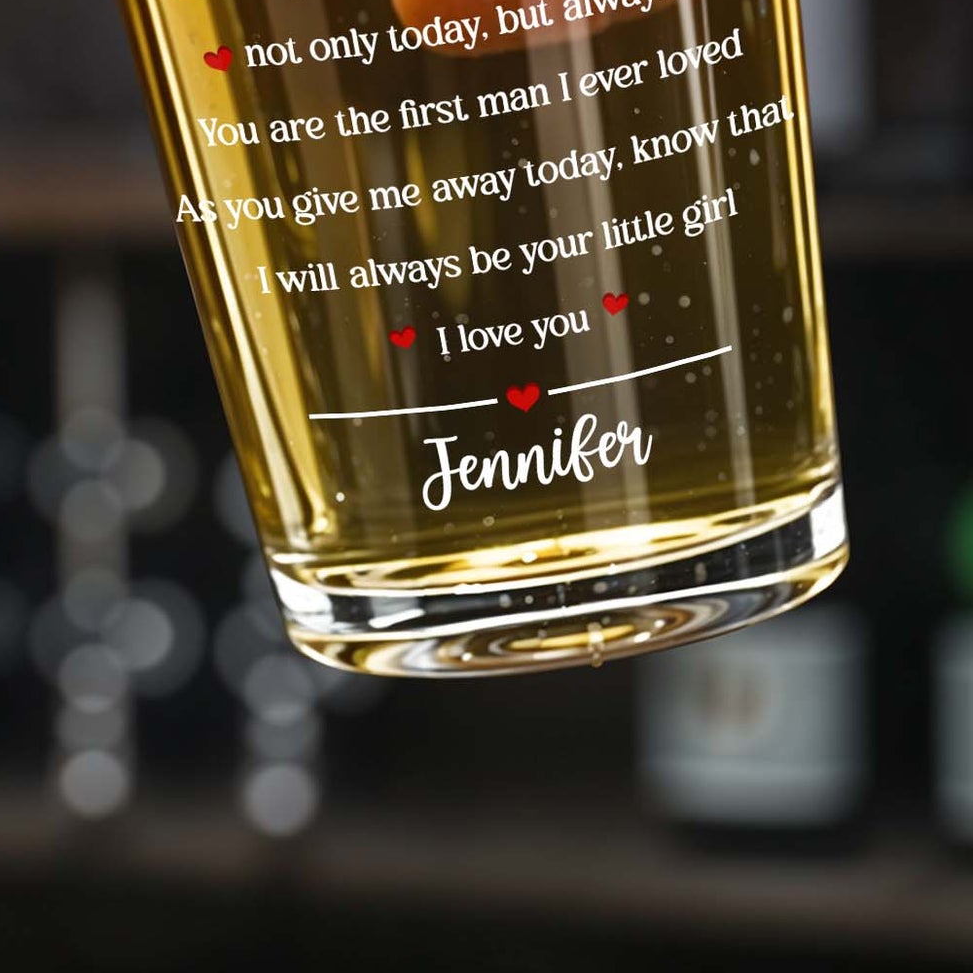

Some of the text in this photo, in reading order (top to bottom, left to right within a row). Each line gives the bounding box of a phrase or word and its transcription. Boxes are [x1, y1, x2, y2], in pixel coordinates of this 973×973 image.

[244, 34, 302, 68] not
[309, 27, 378, 65] only
[386, 16, 488, 52] today,
[495, 0, 554, 35] but
[197, 27, 744, 147] You are the first man I ever loved
[176, 94, 794, 229] As you give me away today, know that
[256, 187, 739, 294] I will always be your little girl
[435, 308, 591, 355] I love you
[422, 413, 654, 511] Jennifer
